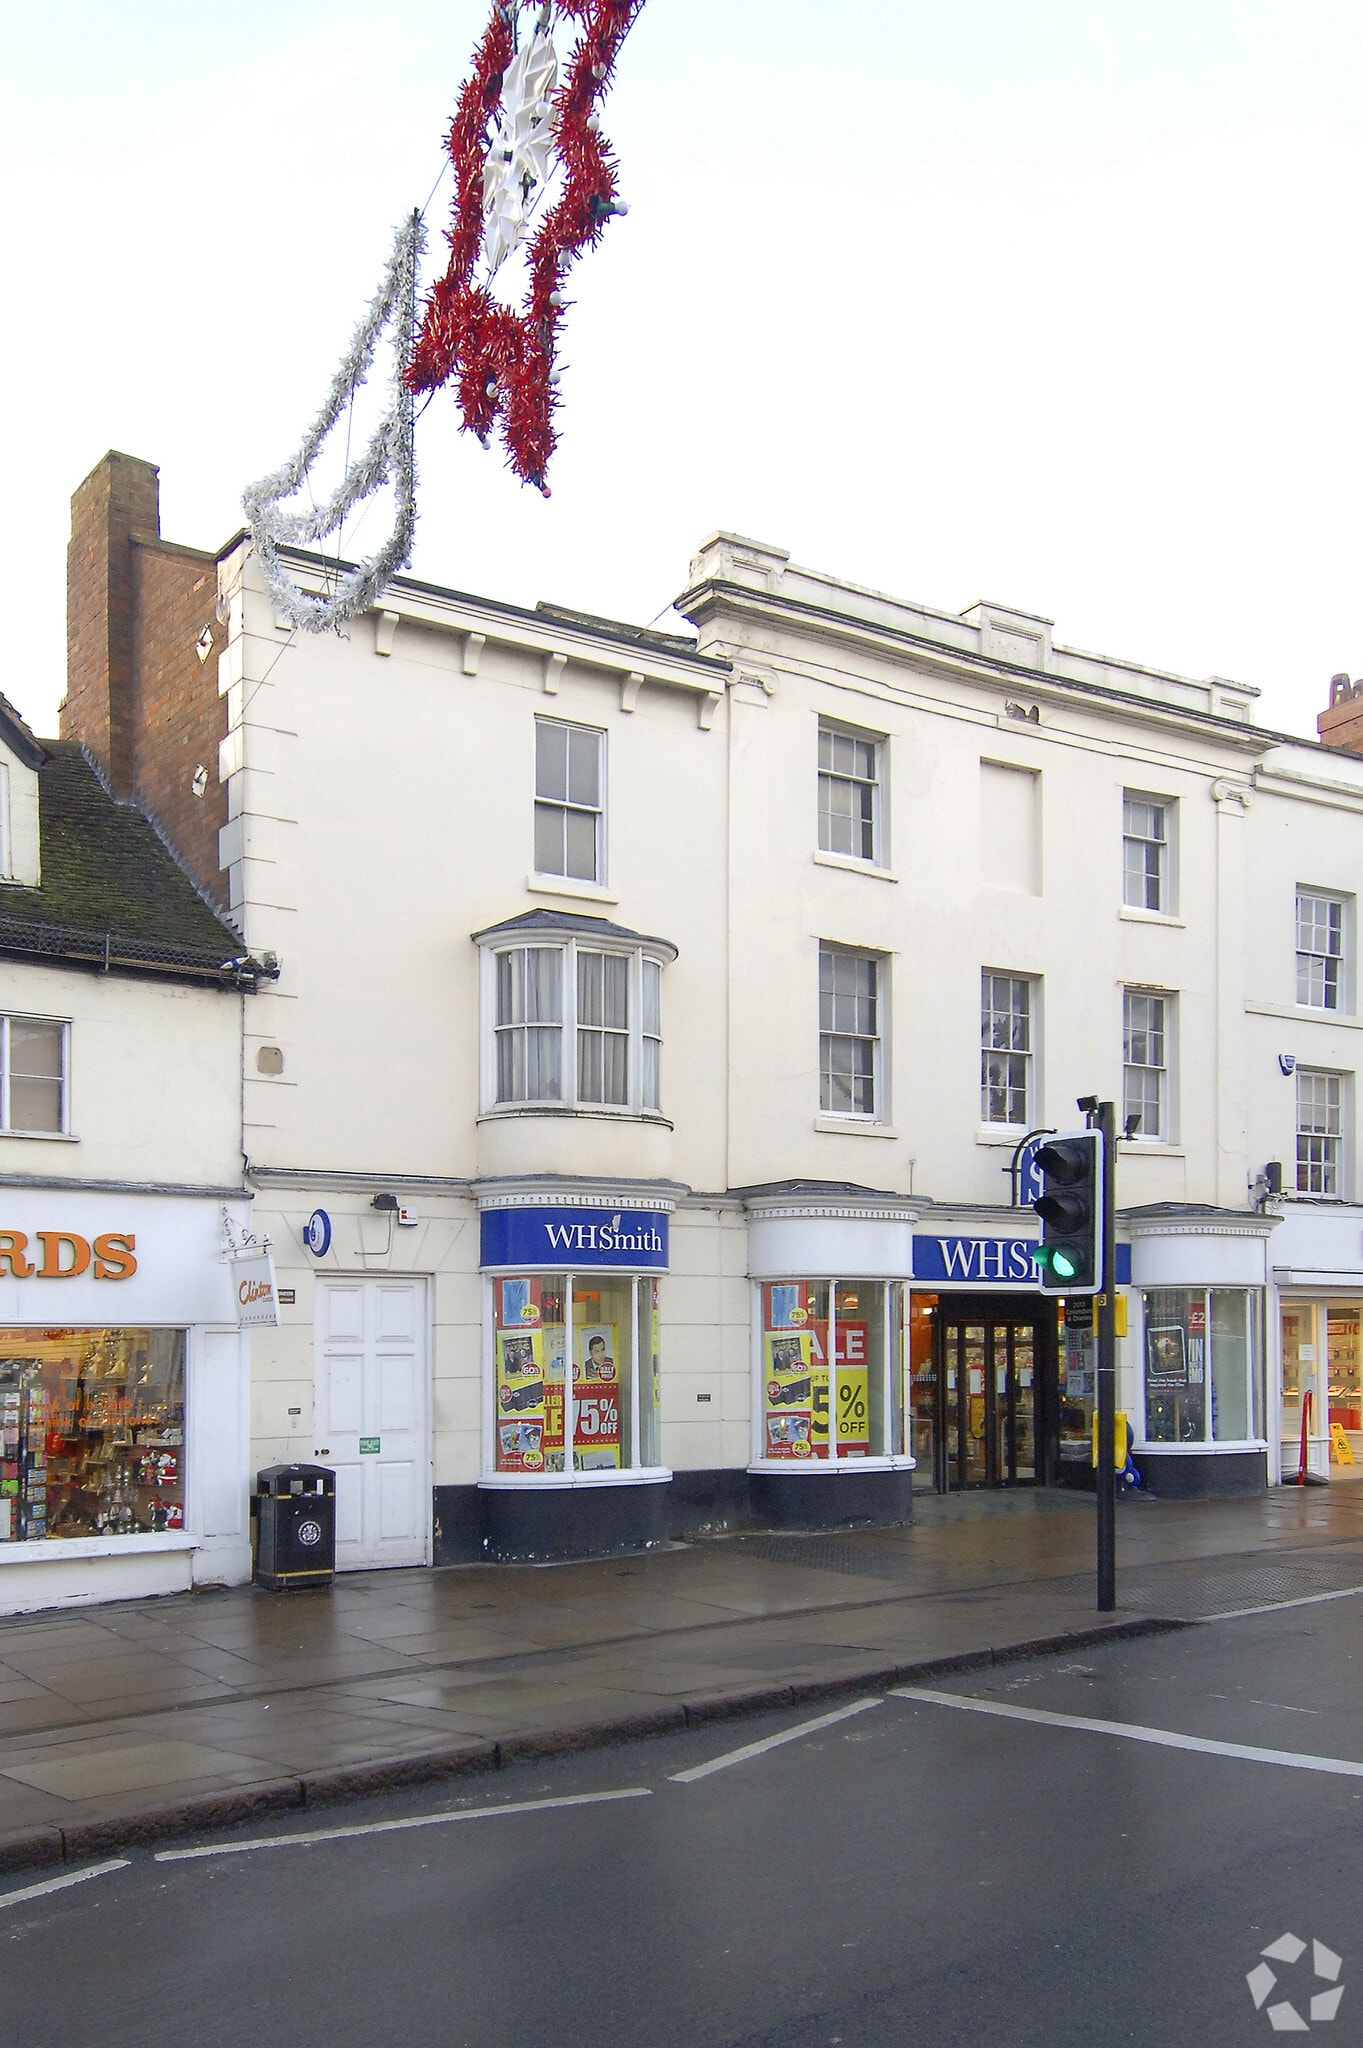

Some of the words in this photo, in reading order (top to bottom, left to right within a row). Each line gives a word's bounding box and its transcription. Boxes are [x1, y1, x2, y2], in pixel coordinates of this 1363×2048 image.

[544, 1223, 663, 1252] WHSmith
[0, 1230, 137, 1280] RDS
[810, 1330, 864, 1359] ALE
[544, 1408, 562, 1436] LE
[600, 1422, 618, 1435] OFF
[840, 1421, 865, 1434] OFF
